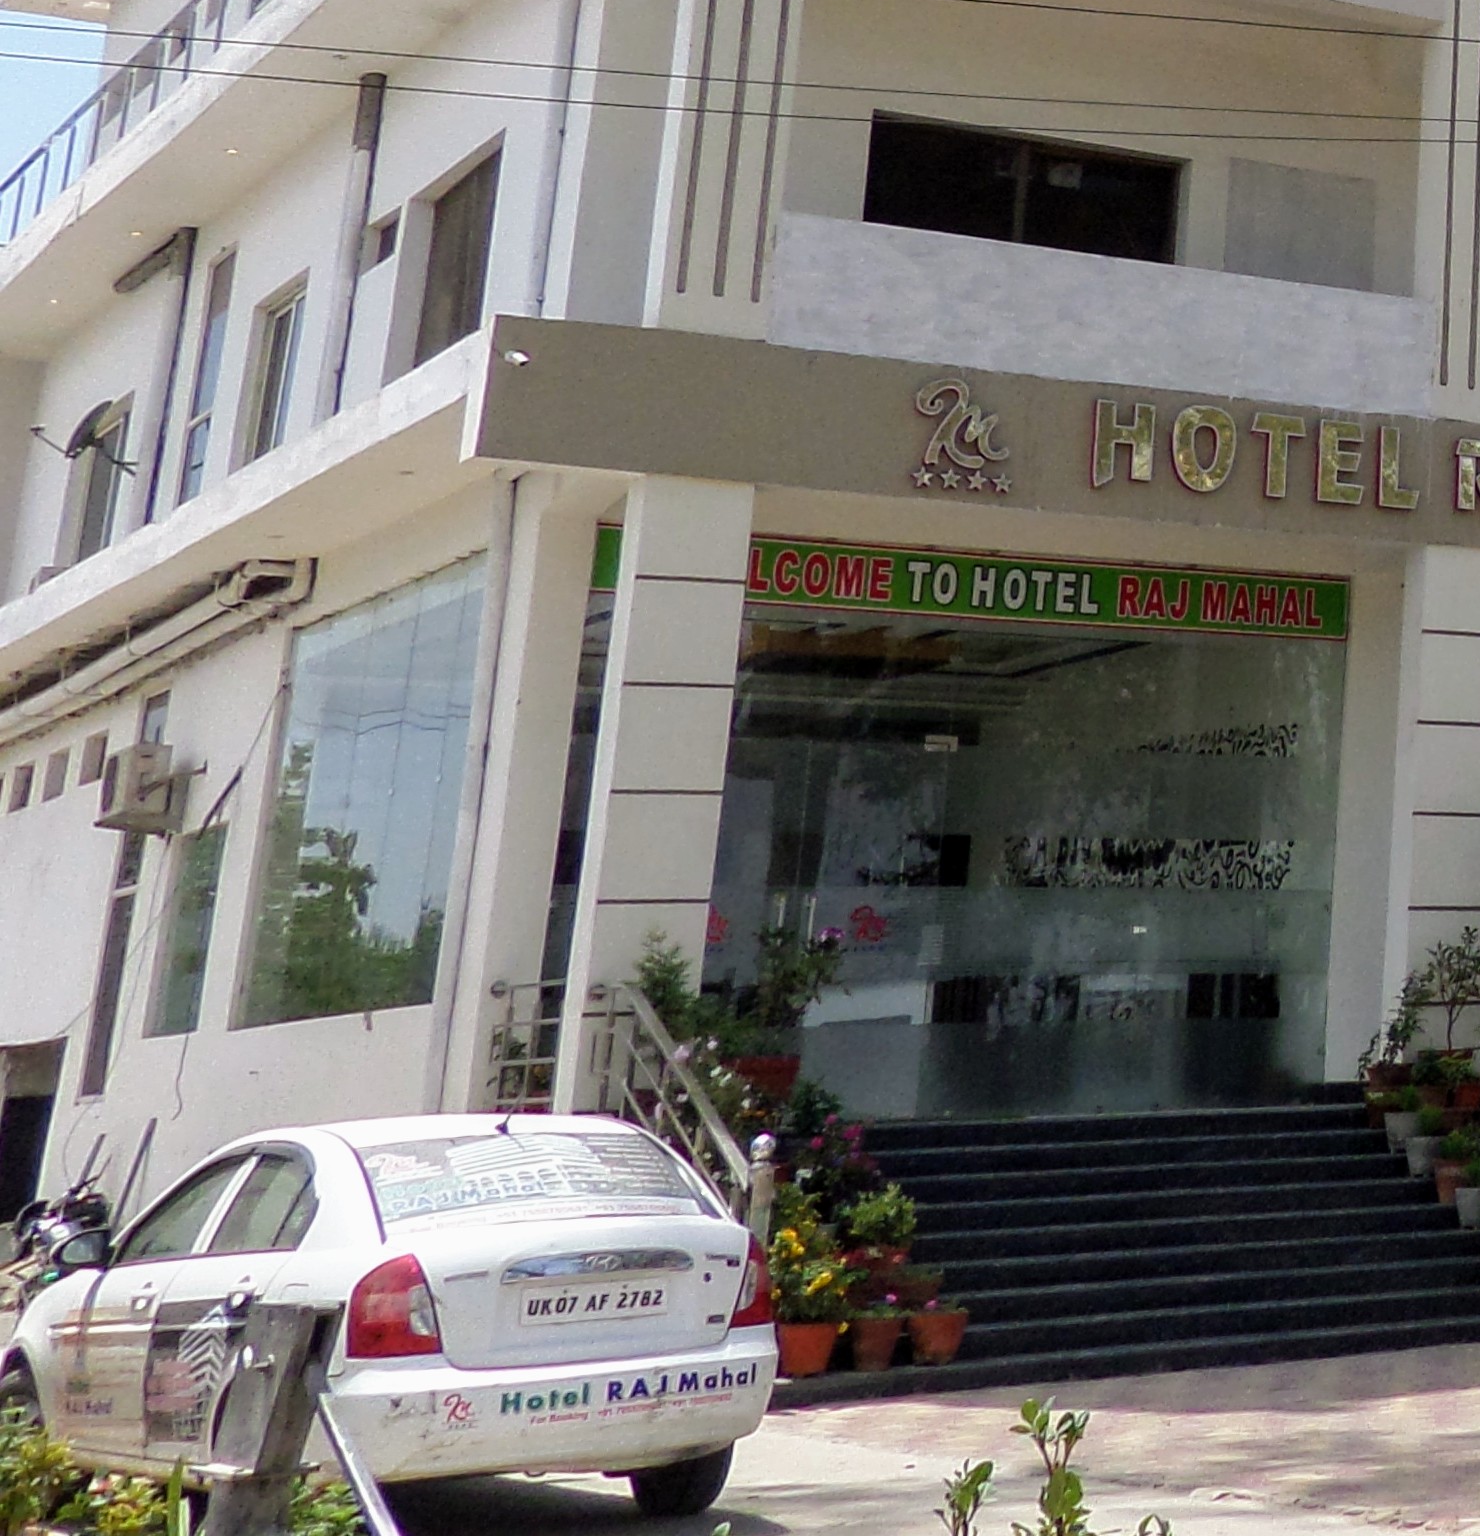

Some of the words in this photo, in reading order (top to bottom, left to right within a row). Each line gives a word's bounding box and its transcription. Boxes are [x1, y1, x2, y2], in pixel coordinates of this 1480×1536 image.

[1092, 398, 1420, 509] HOTEL
[749, 547, 894, 601] LCOME
[907, 560, 959, 605] TO
[970, 565, 1098, 615] HOTEL
[1117, 574, 1190, 621] RAJ
[1201, 579, 1322, 628] MAHAL
[584, 1293, 610, 1313] AF
[616, 1289, 664, 1310] 2782
[500, 1381, 590, 1414] Hotel
[606, 1374, 668, 1402] RAJ
[677, 1362, 758, 1393] Mahal
